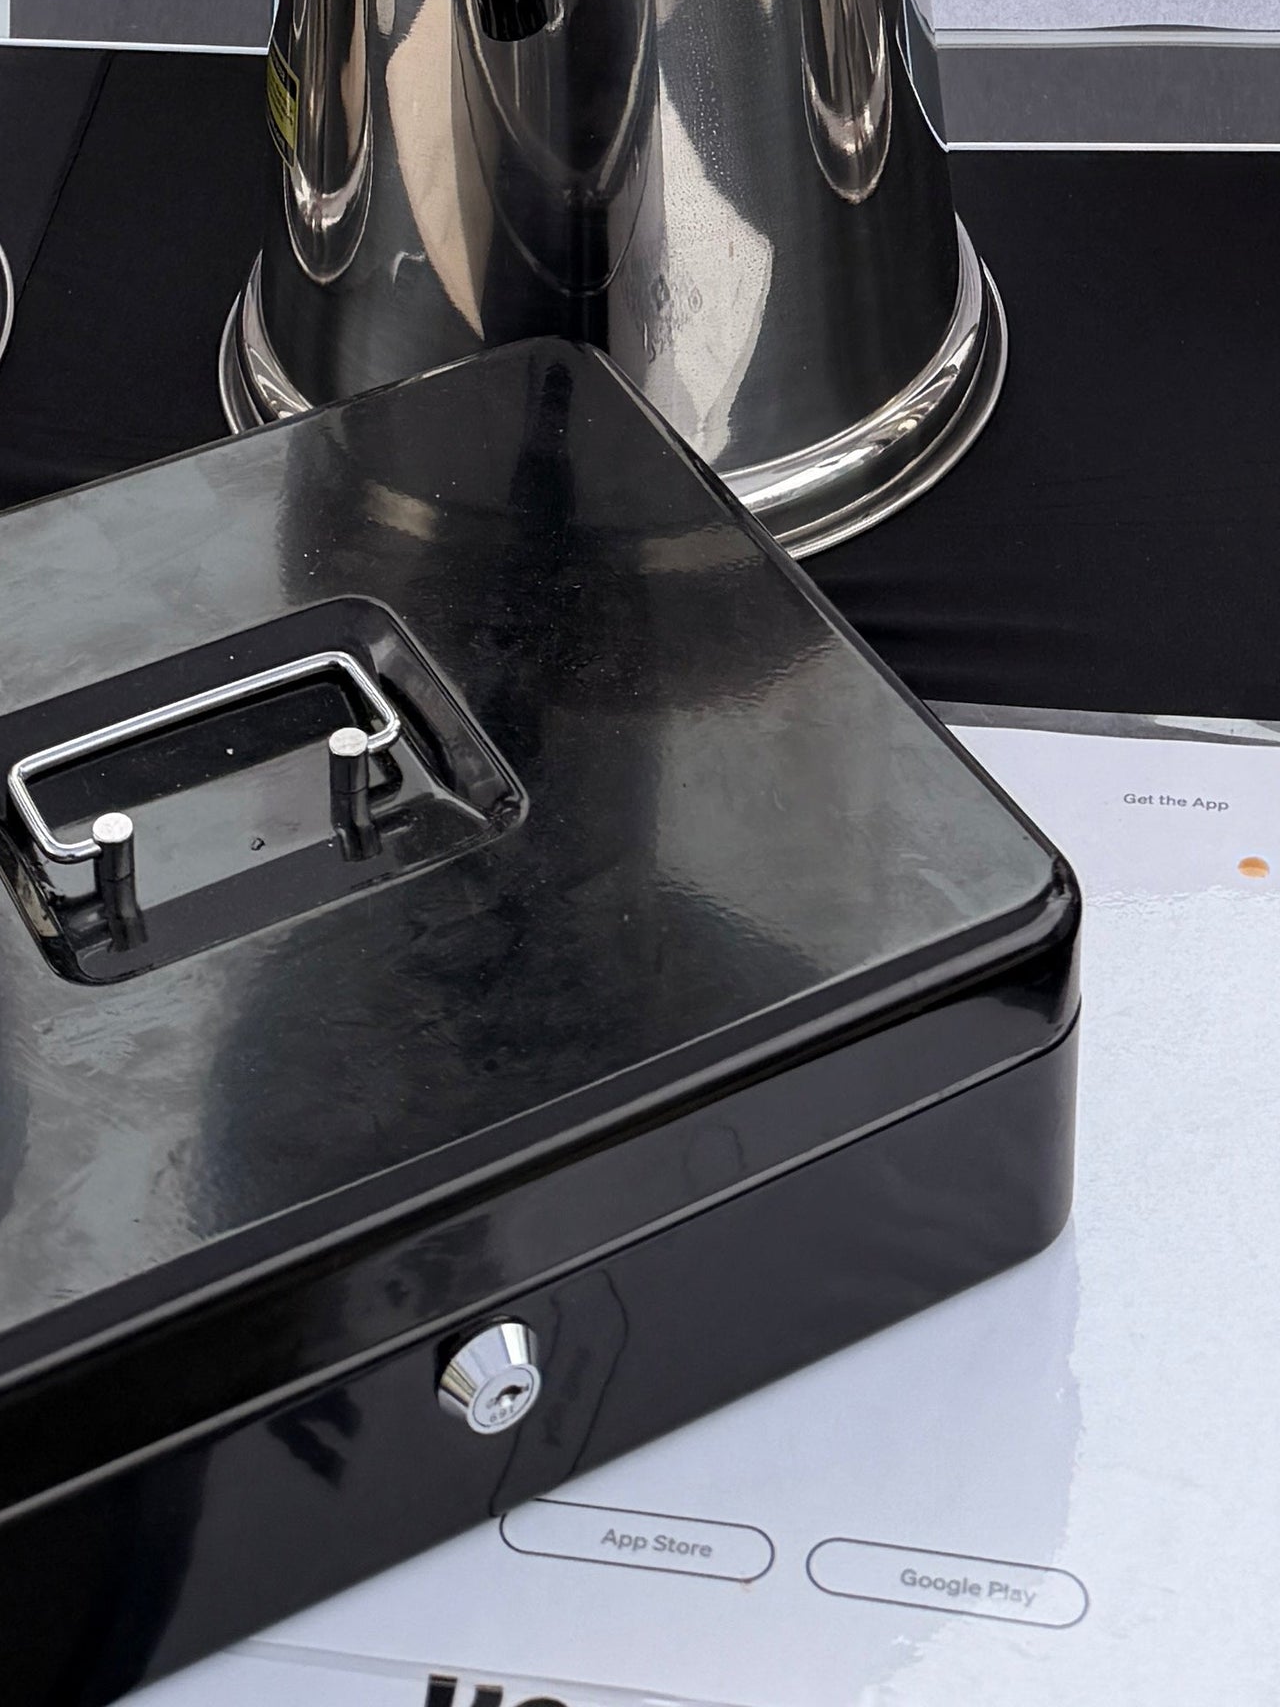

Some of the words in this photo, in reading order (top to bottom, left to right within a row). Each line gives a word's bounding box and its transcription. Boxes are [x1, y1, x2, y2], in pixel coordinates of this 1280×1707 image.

[1123, 793, 1154, 805] Get
[1159, 794, 1187, 807] the
[1192, 797, 1229, 812] App
[601, 1525, 647, 1560] App
[651, 1533, 714, 1560] Store
[900, 1568, 984, 1602] Google
[986, 1581, 1037, 1609] Play
